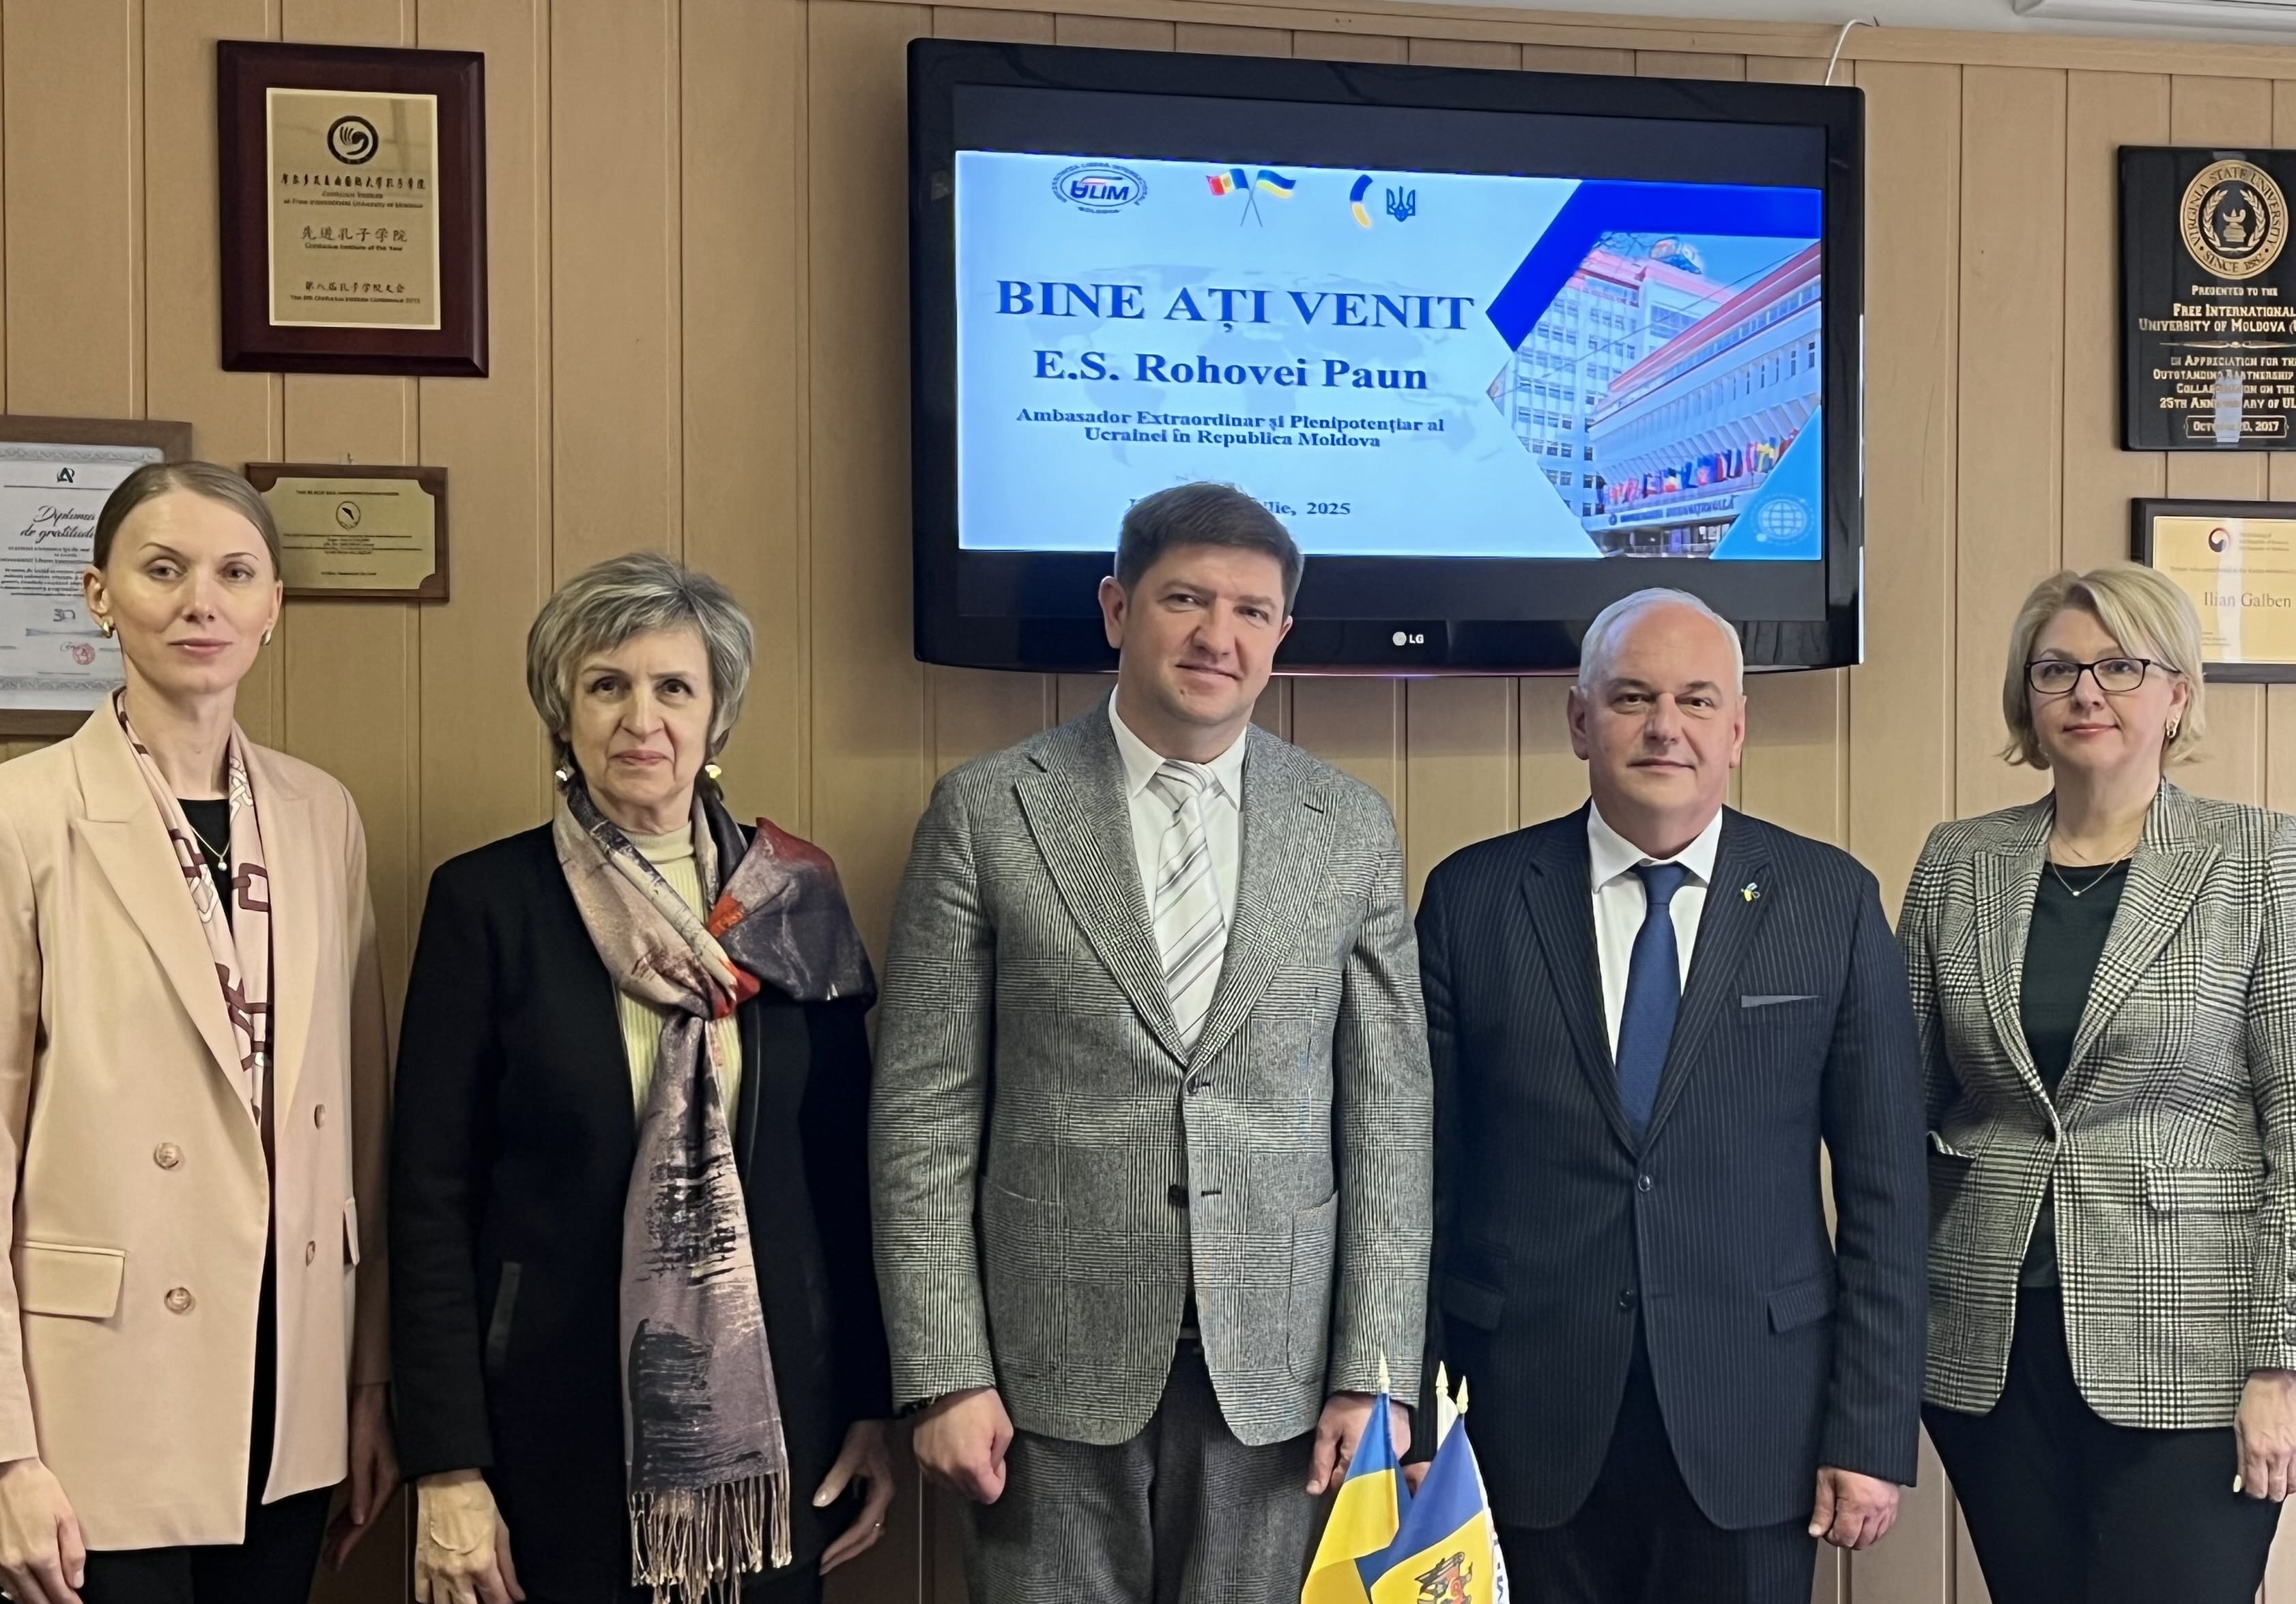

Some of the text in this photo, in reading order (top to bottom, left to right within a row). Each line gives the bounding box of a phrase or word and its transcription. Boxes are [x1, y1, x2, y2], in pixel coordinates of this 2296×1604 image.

[2187, 167, 2282, 247] VIRGINIA STATE UNIVERSITY
[2202, 250, 2239, 273] SINCE
[2247, 287, 2258, 296] TO
[994, 280, 1475, 333] BINE AȚI VENIT
[2173, 303, 2296, 317] FREE INTERNATIONAL
[2138, 318, 2211, 332] UNIVERSITY
[2214, 320, 2228, 332] OF
[2231, 319, 2286, 332] MOLDOVA
[1033, 350, 1429, 390] E.S. Rohovei Paun
[1016, 408, 1132, 424] Ambasador
[1136, 411, 1266, 428] Extraordinar
[1427, 418, 1445, 431] al
[2255, 421, 2280, 431] 2017
[1084, 427, 1168, 442] Ucrainei
[1198, 430, 1292, 447] Republica
[1297, 432, 1381, 447] Moldova
[1306, 502, 1351, 515] 2025
[2204, 591, 2291, 607] Ilian Galben
[1408, 633, 1424, 644] LG
